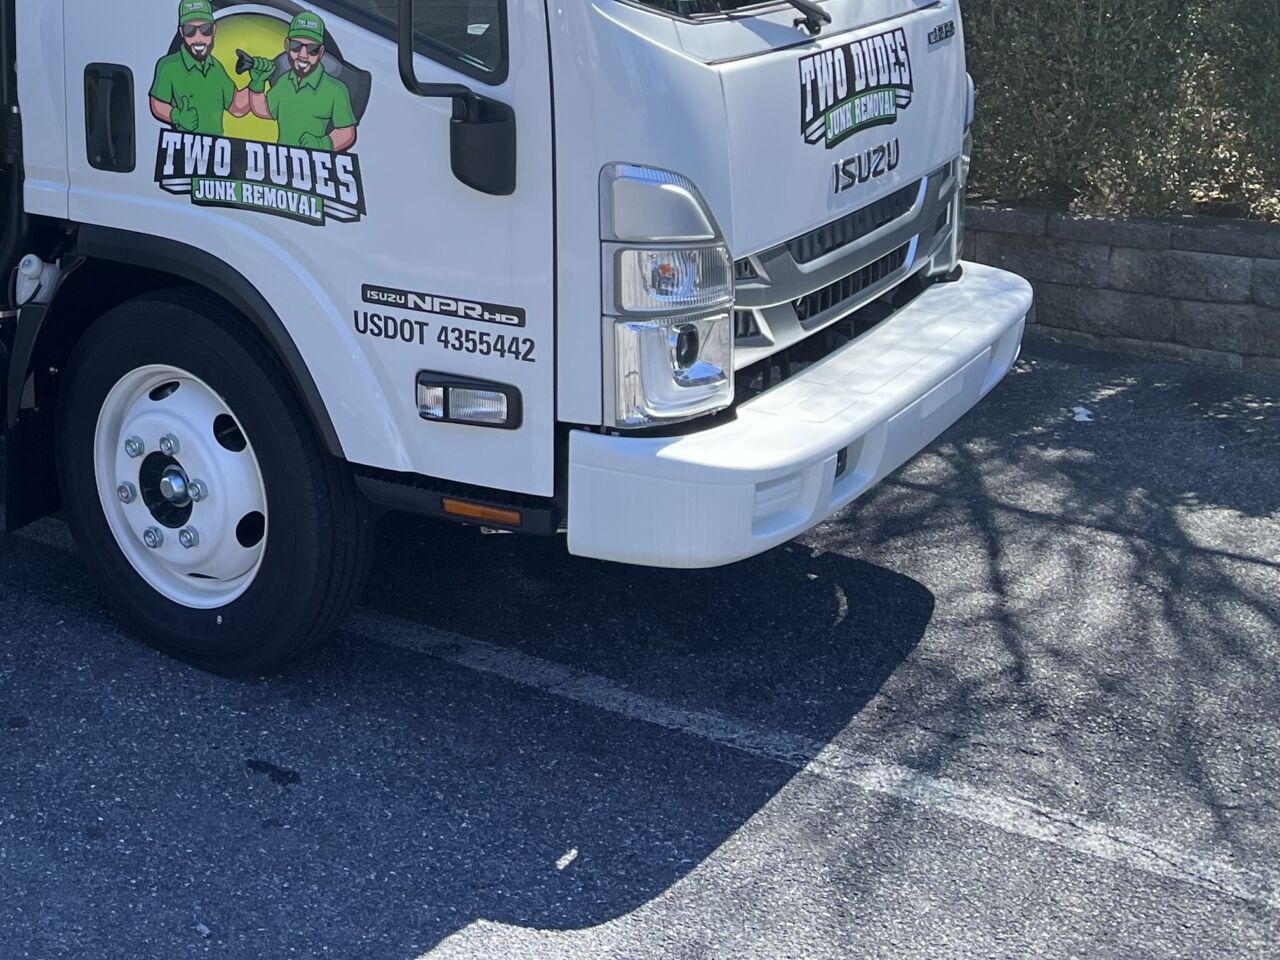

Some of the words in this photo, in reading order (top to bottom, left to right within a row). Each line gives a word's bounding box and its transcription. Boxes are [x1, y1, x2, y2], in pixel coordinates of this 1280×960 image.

[801, 47, 848, 123] TWO
[850, 29, 912, 91] DUDES
[826, 102, 853, 140] JUNK
[854, 91, 896, 123] REMOVAL
[161, 131, 231, 178] TWO
[245, 141, 359, 206] DUDES
[833, 137, 900, 193] ISUZU
[194, 180, 237, 203] JUNK
[241, 183, 322, 220] REMOVAL
[367, 290, 405, 304] ISUZU
[354, 310, 429, 344] USDOT
[437, 325, 536, 362] 4355442
